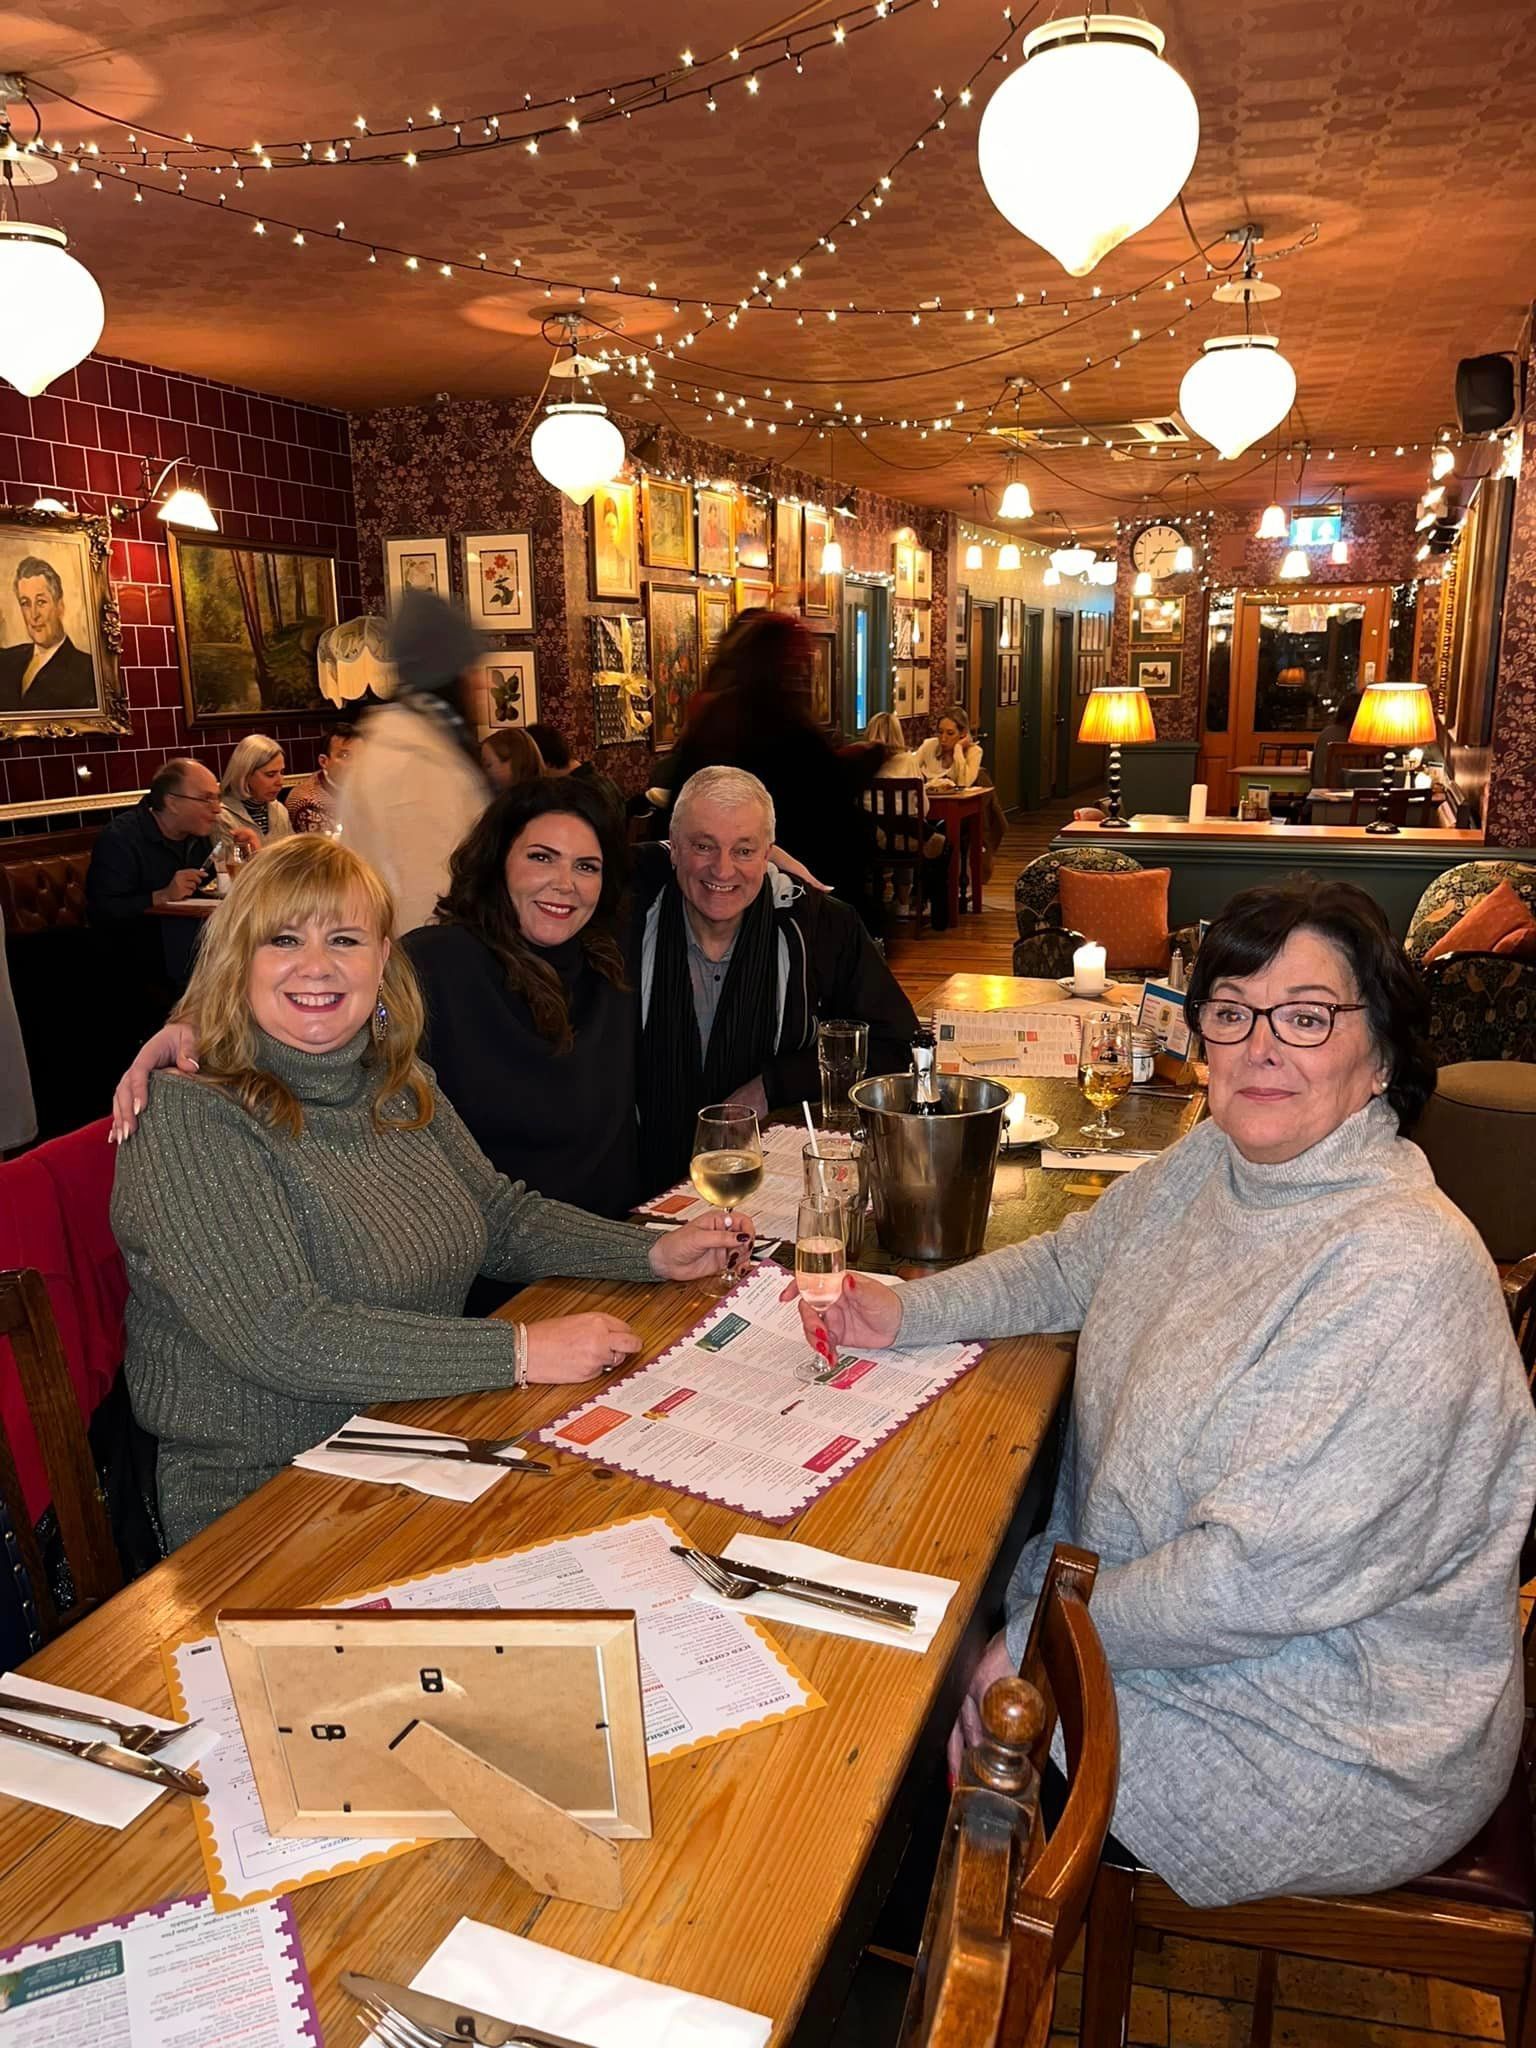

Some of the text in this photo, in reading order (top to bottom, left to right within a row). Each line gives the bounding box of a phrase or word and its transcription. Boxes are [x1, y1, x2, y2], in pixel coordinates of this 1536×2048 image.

[709, 1613, 726, 1621] TEA
[698, 1644, 752, 1665] ICED COFFEE
[758, 1692, 791, 1708] COFFEE
